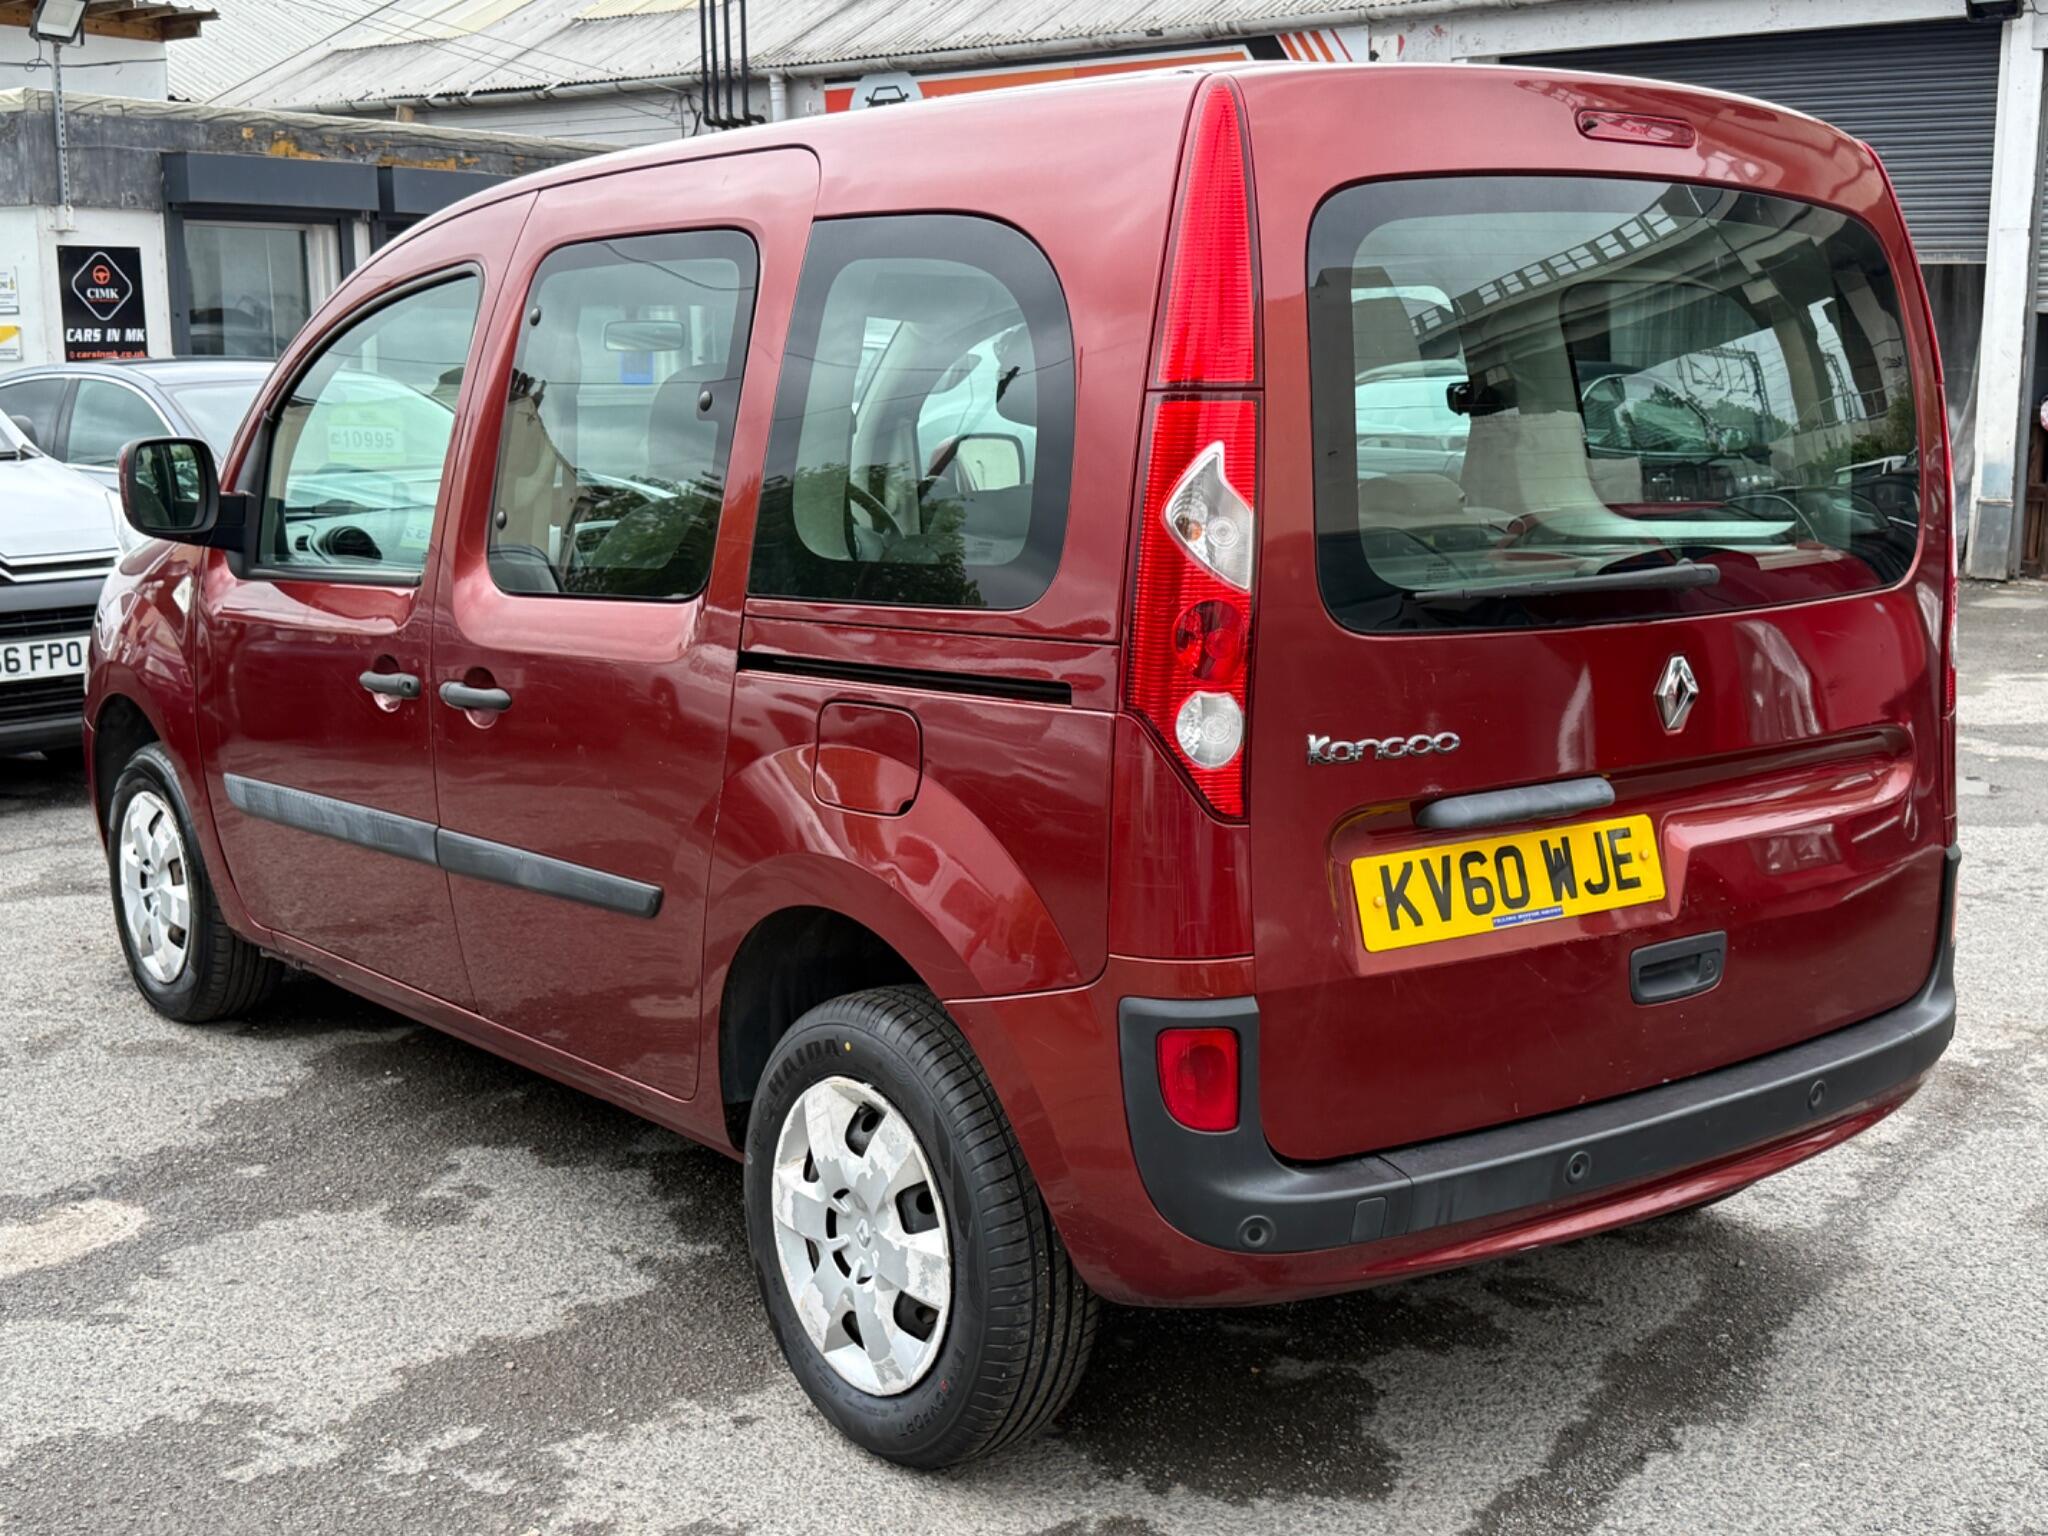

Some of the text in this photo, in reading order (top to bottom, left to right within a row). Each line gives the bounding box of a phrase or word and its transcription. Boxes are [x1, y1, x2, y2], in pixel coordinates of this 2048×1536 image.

[86, 287, 120, 299] CIMK
[66, 328, 145, 342] CARS IN MK
[0, 641, 82, 673] 6 FPO
[1307, 731, 1461, 765] Kangoo
[1380, 826, 1642, 931] KV60 WJE
[766, 1037, 842, 1098] HAIDA
